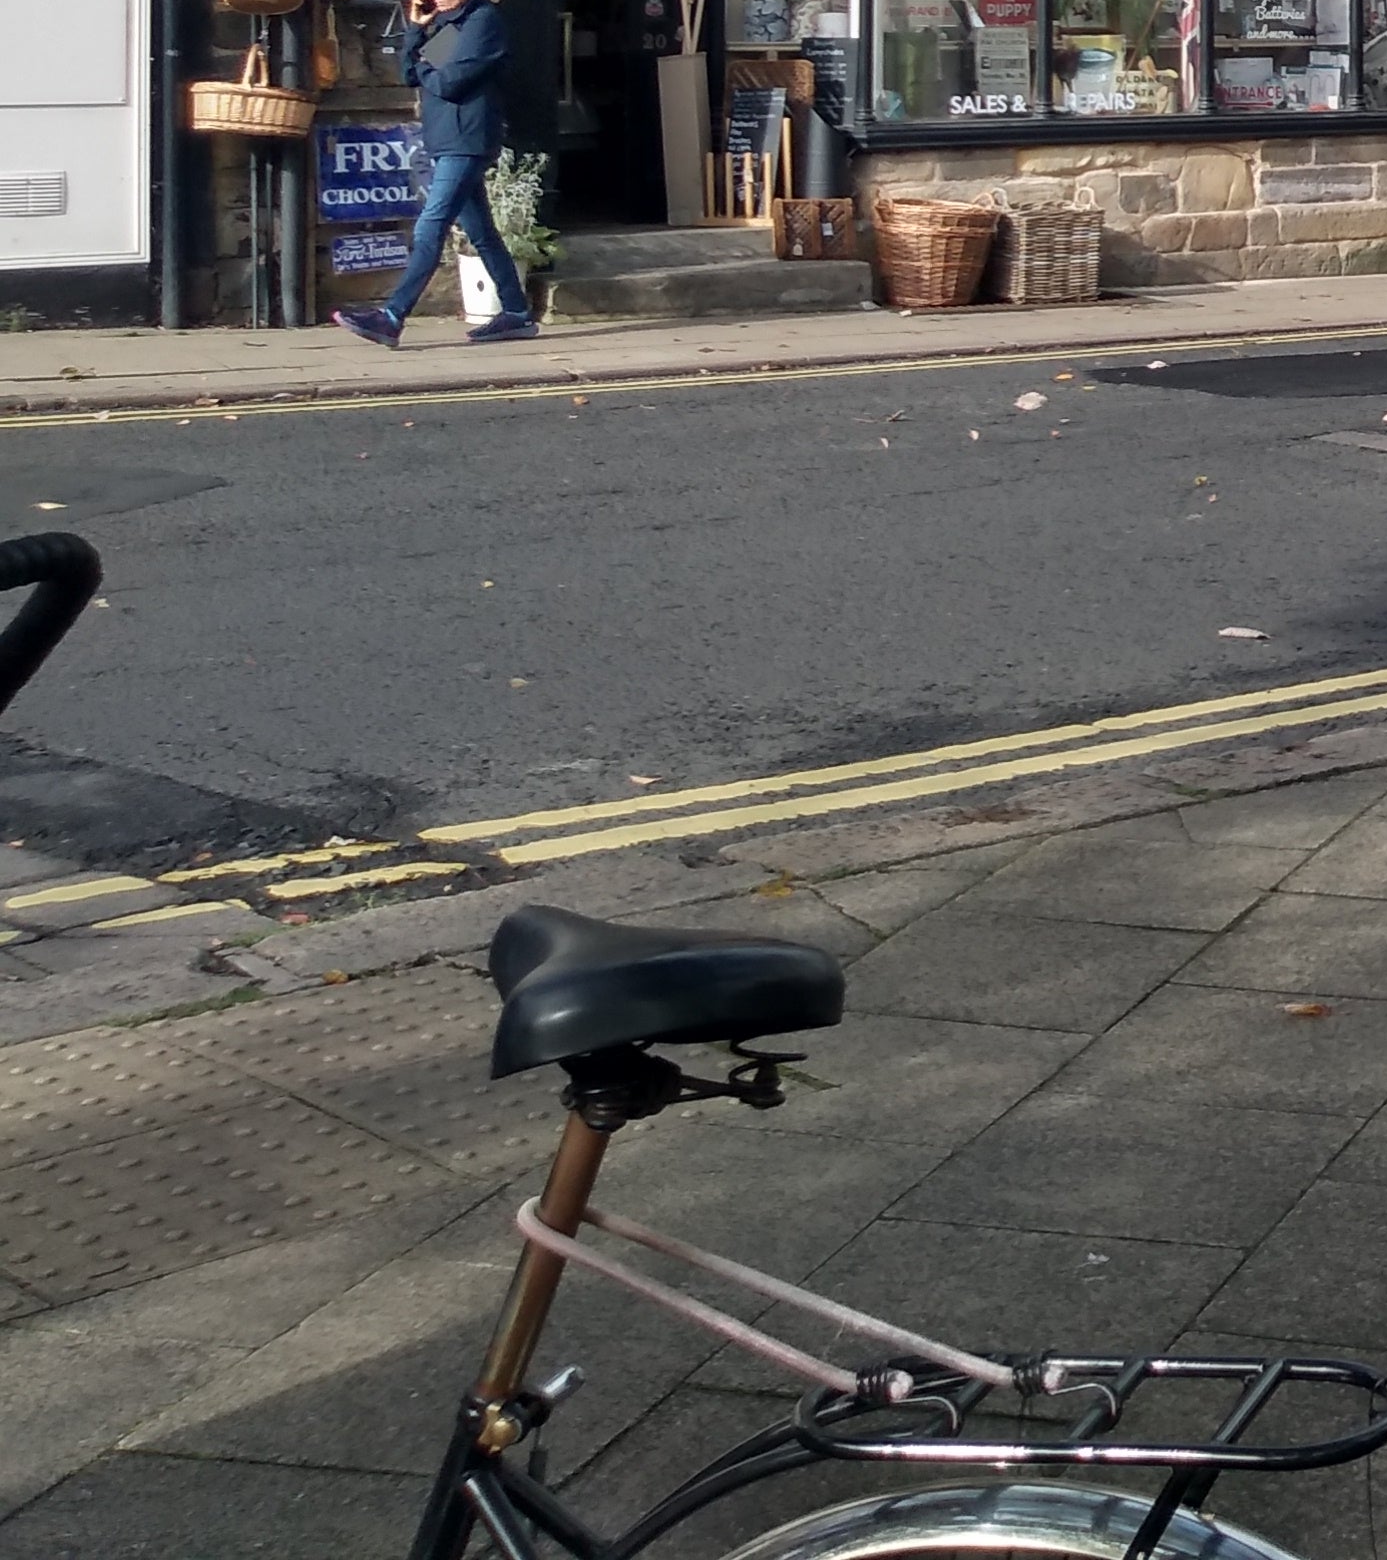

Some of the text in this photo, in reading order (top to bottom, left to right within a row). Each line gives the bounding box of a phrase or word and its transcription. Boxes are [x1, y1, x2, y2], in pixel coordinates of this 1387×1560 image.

[986, 3, 1033, 18] PUPPY
[950, 94, 1011, 114] SALES
[1012, 94, 1027, 114] &
[1065, 92, 1136, 112] REPAIRS
[1217, 86, 1284, 100] NTRANCE
[333, 141, 434, 174] FRY'
[322, 185, 431, 206] CHOCOLA
